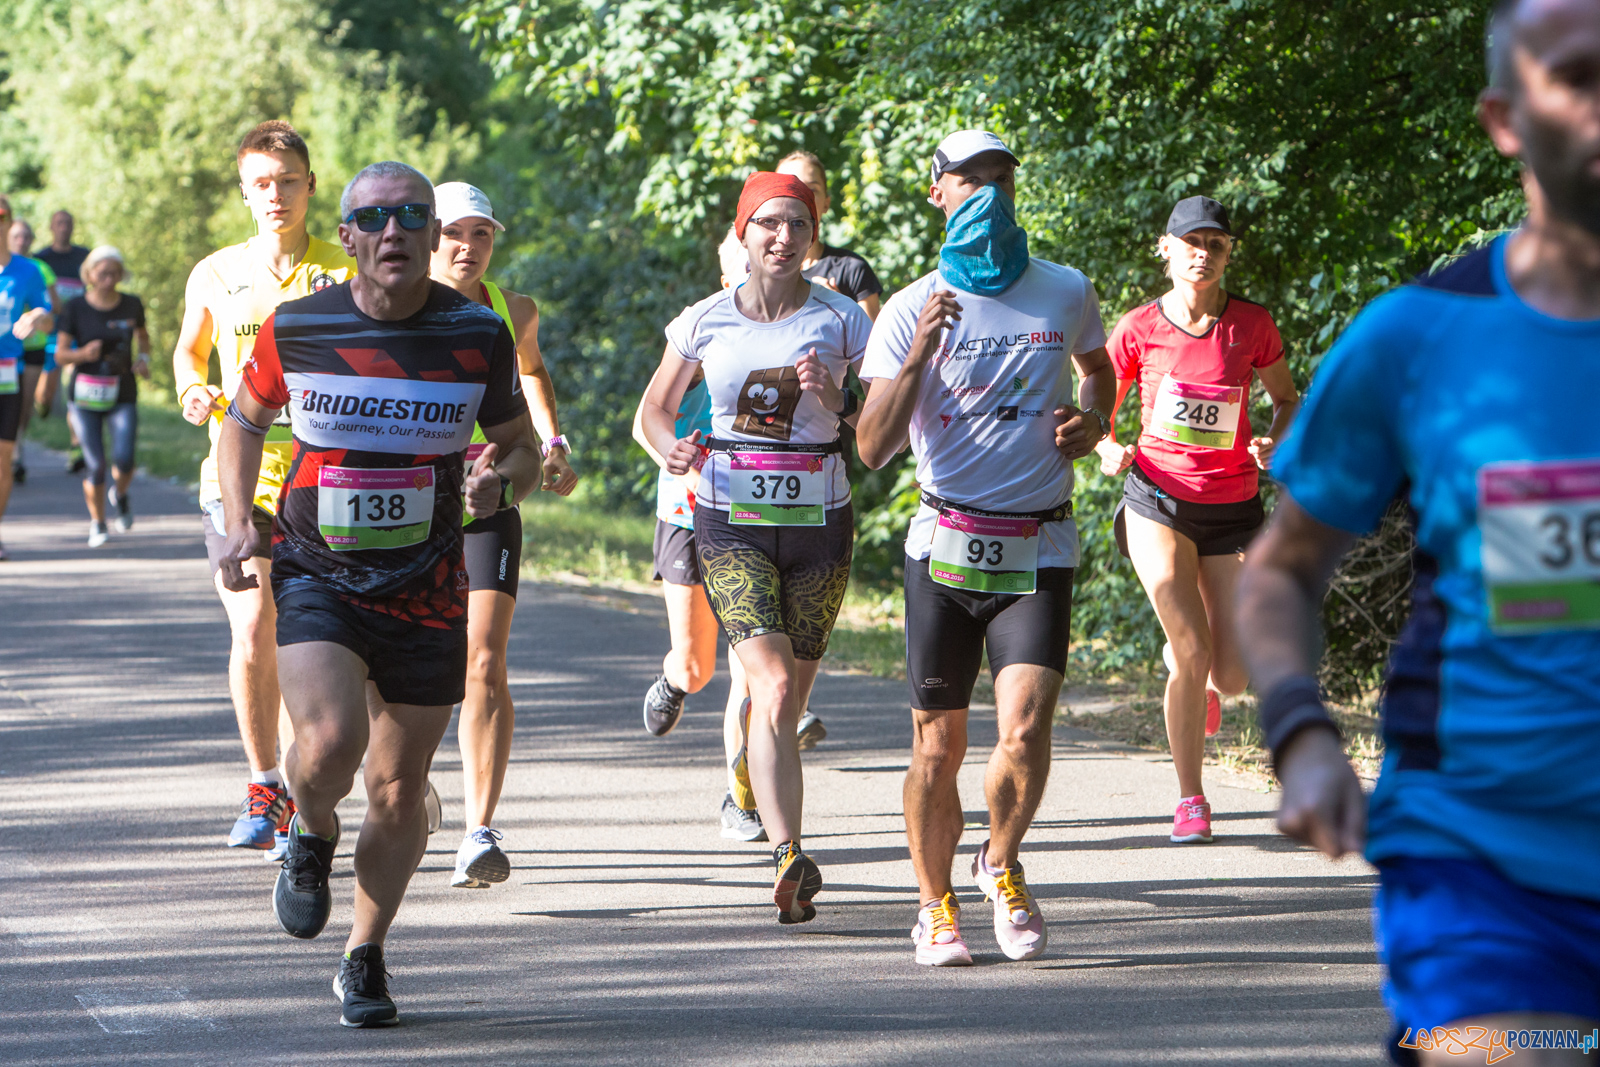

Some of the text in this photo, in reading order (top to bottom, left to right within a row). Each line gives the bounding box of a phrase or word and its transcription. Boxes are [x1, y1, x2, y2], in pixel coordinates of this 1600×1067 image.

[302, 389, 467, 423] BRIDGESTONE
[1173, 401, 1219, 426] 248
[309, 418, 456, 439] Your Journey, Our Passion
[751, 474, 801, 500] 379
[347, 494, 406, 522] 138
[967, 538, 1004, 566] 93
[935, 570, 964, 581] 22.06.2018
